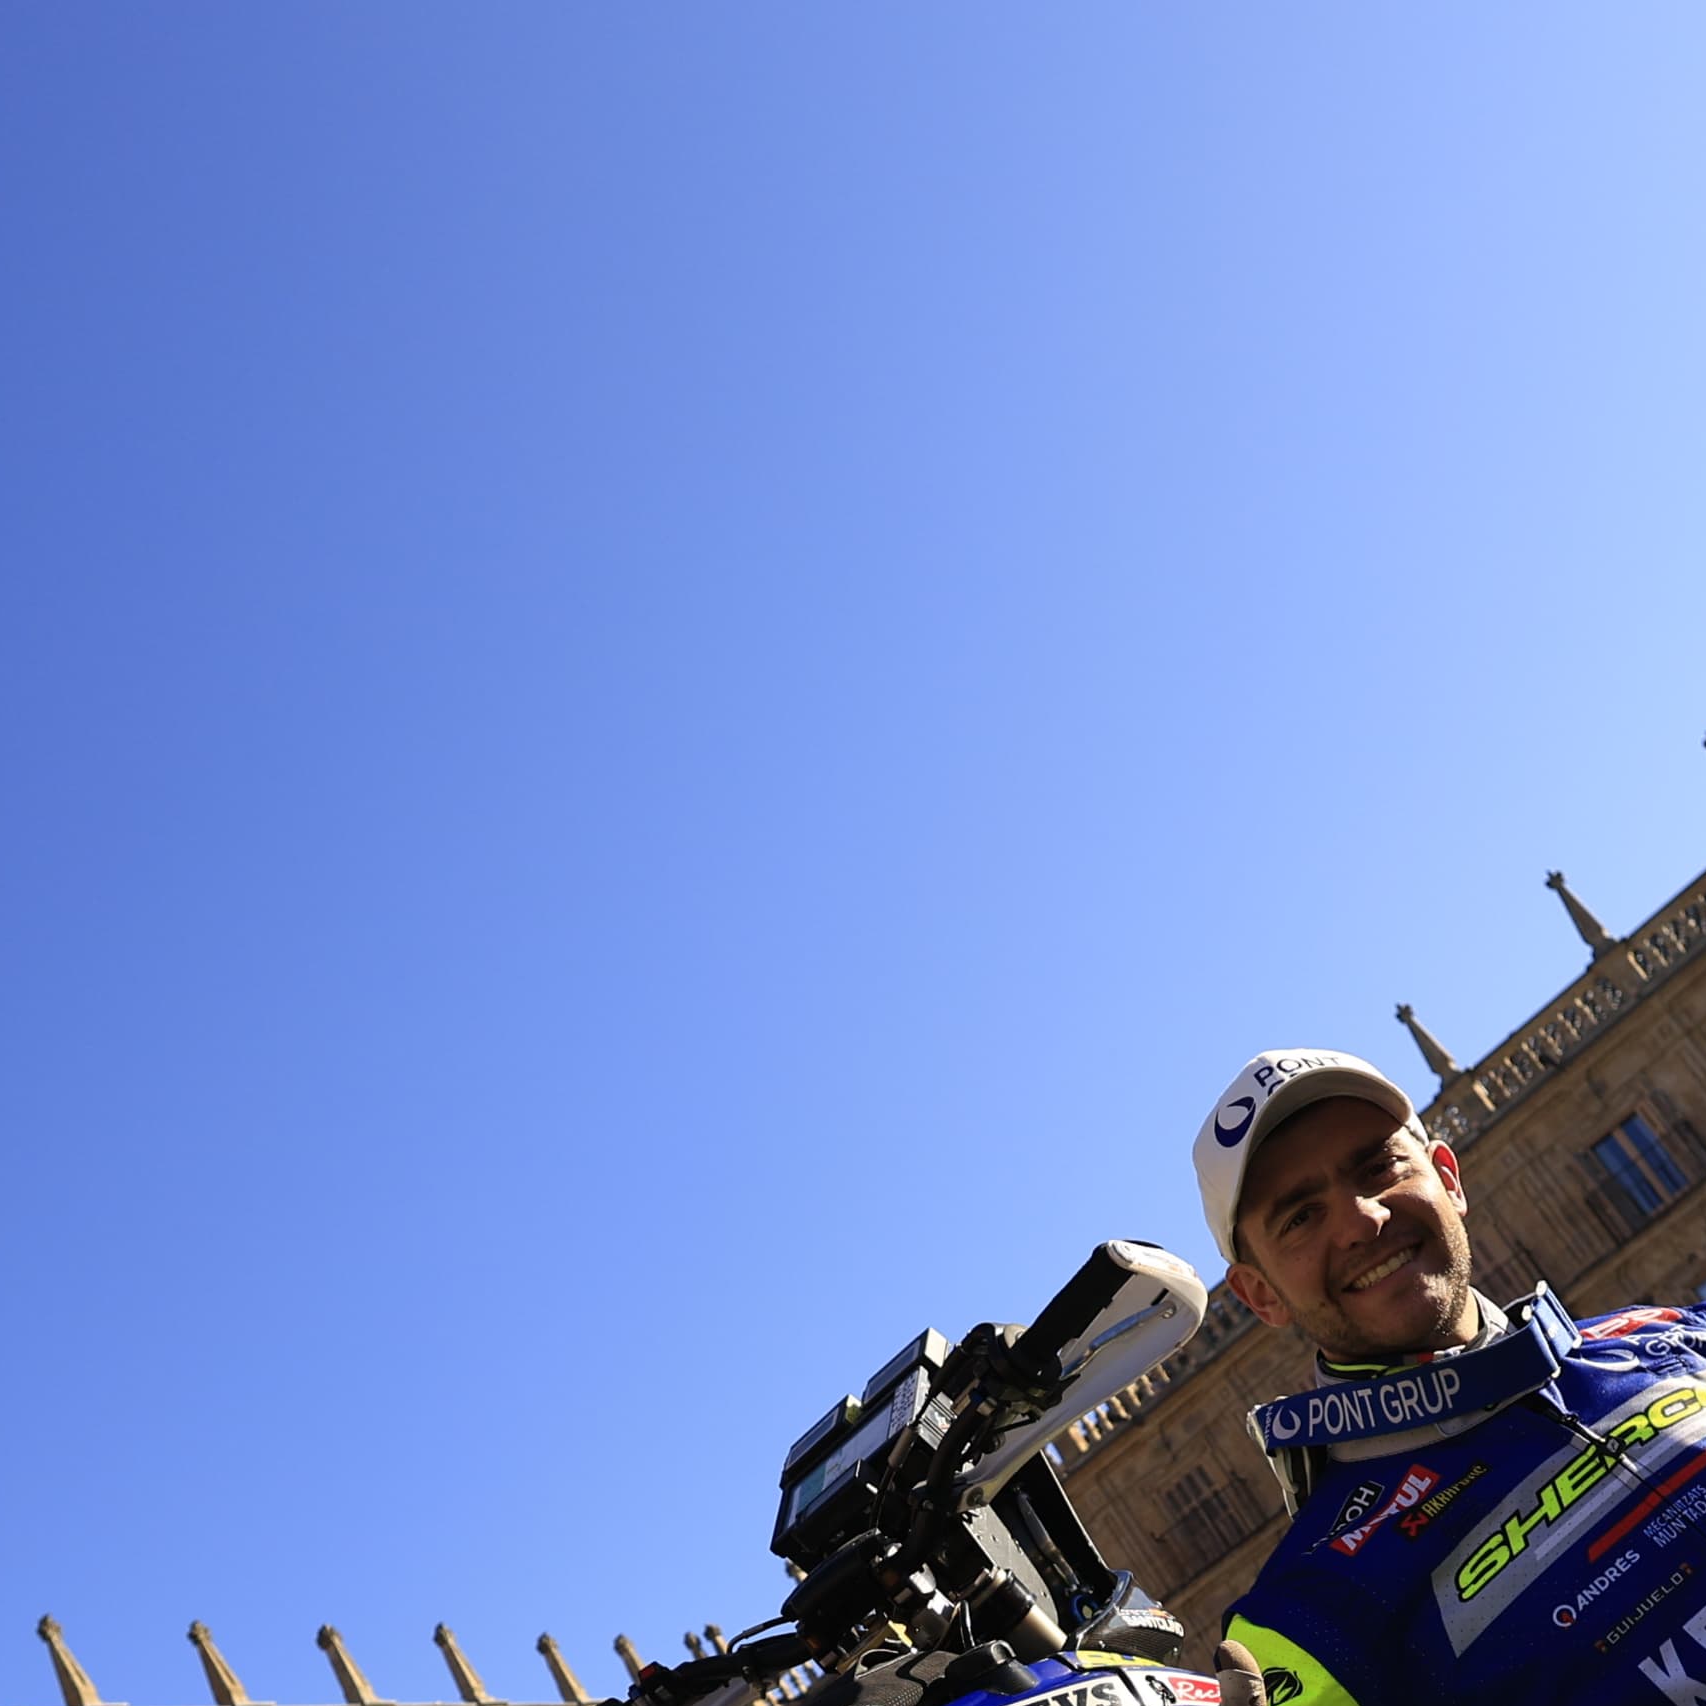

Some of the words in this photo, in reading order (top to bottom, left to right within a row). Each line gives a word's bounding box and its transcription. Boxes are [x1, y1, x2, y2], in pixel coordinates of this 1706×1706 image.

[1253, 1056, 1341, 1088] PONT
[1307, 1388, 1376, 1438] PONT
[1380, 1367, 1462, 1414] GRUP
[1606, 1568, 1685, 1647] GUIJUELO
